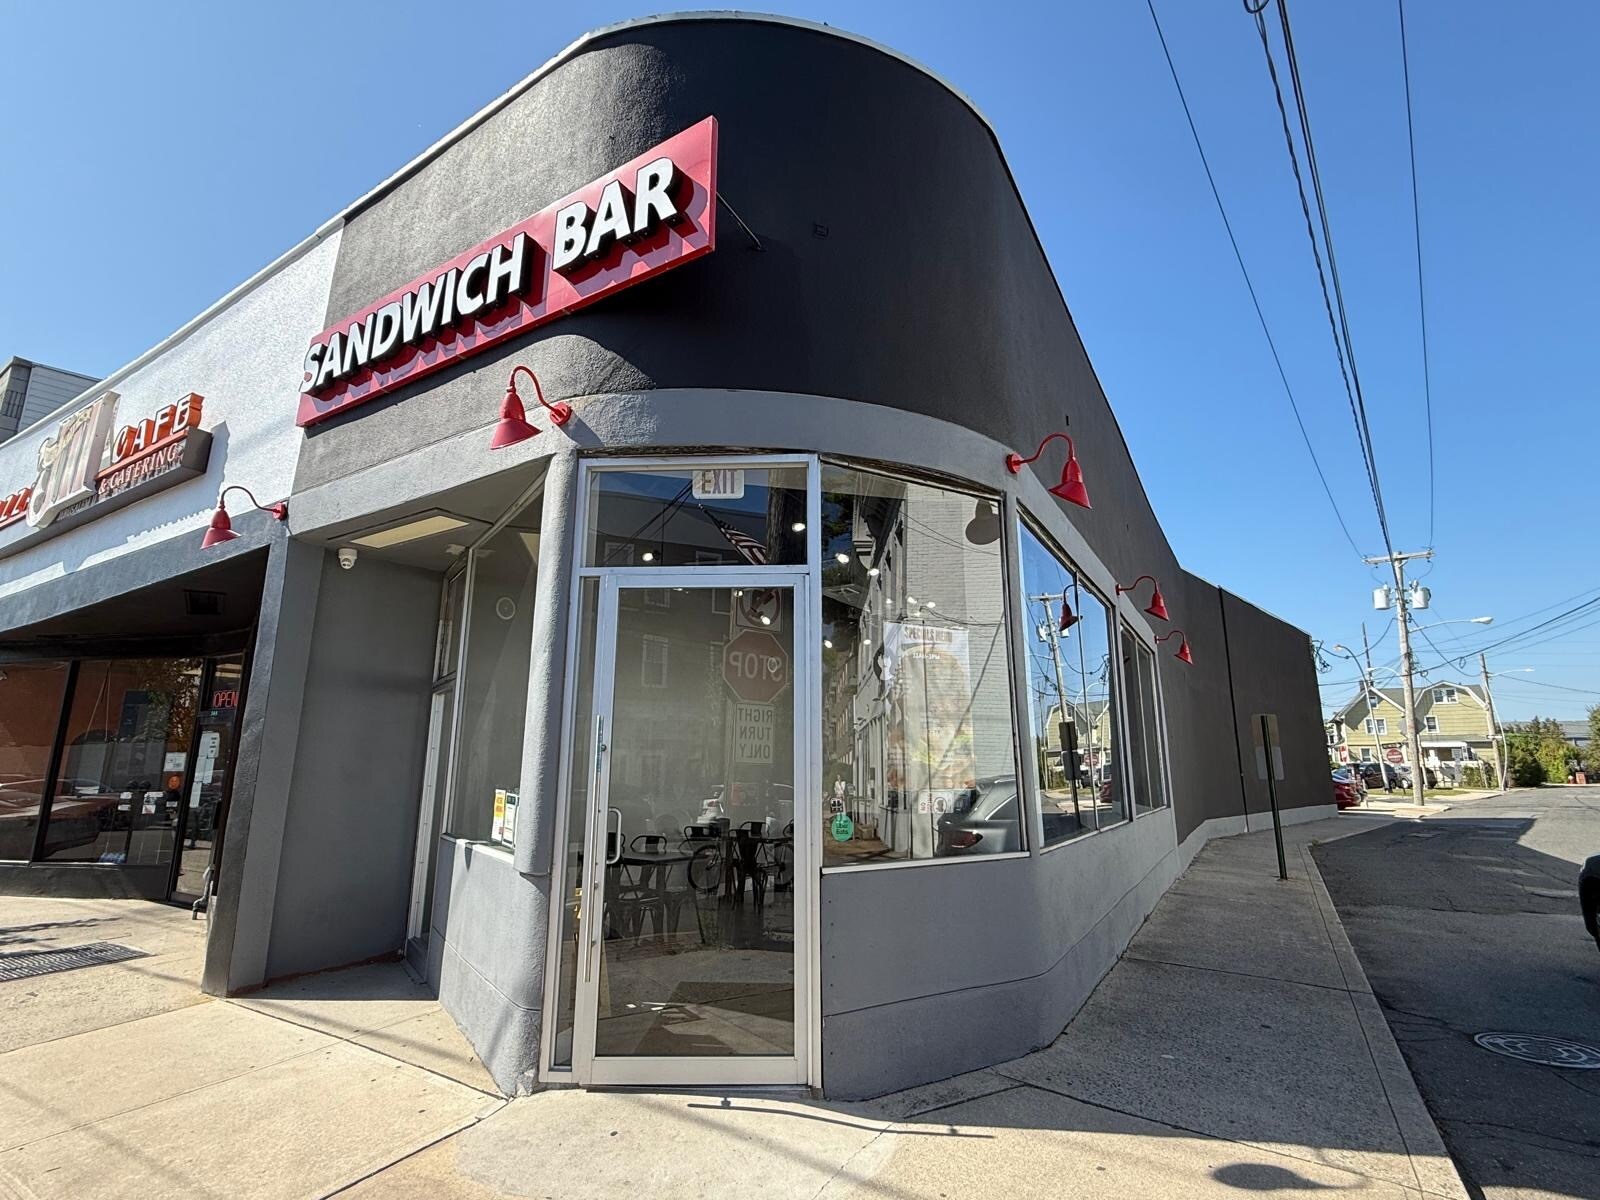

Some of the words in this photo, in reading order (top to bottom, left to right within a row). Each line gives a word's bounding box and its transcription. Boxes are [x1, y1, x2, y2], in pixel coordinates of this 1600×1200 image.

[298, 231, 527, 394] SANDWICH
[552, 156, 679, 271] BAR
[109, 442, 179, 490] CATERING
[701, 469, 735, 494] EXIT
[213, 691, 239, 708] OPEN
